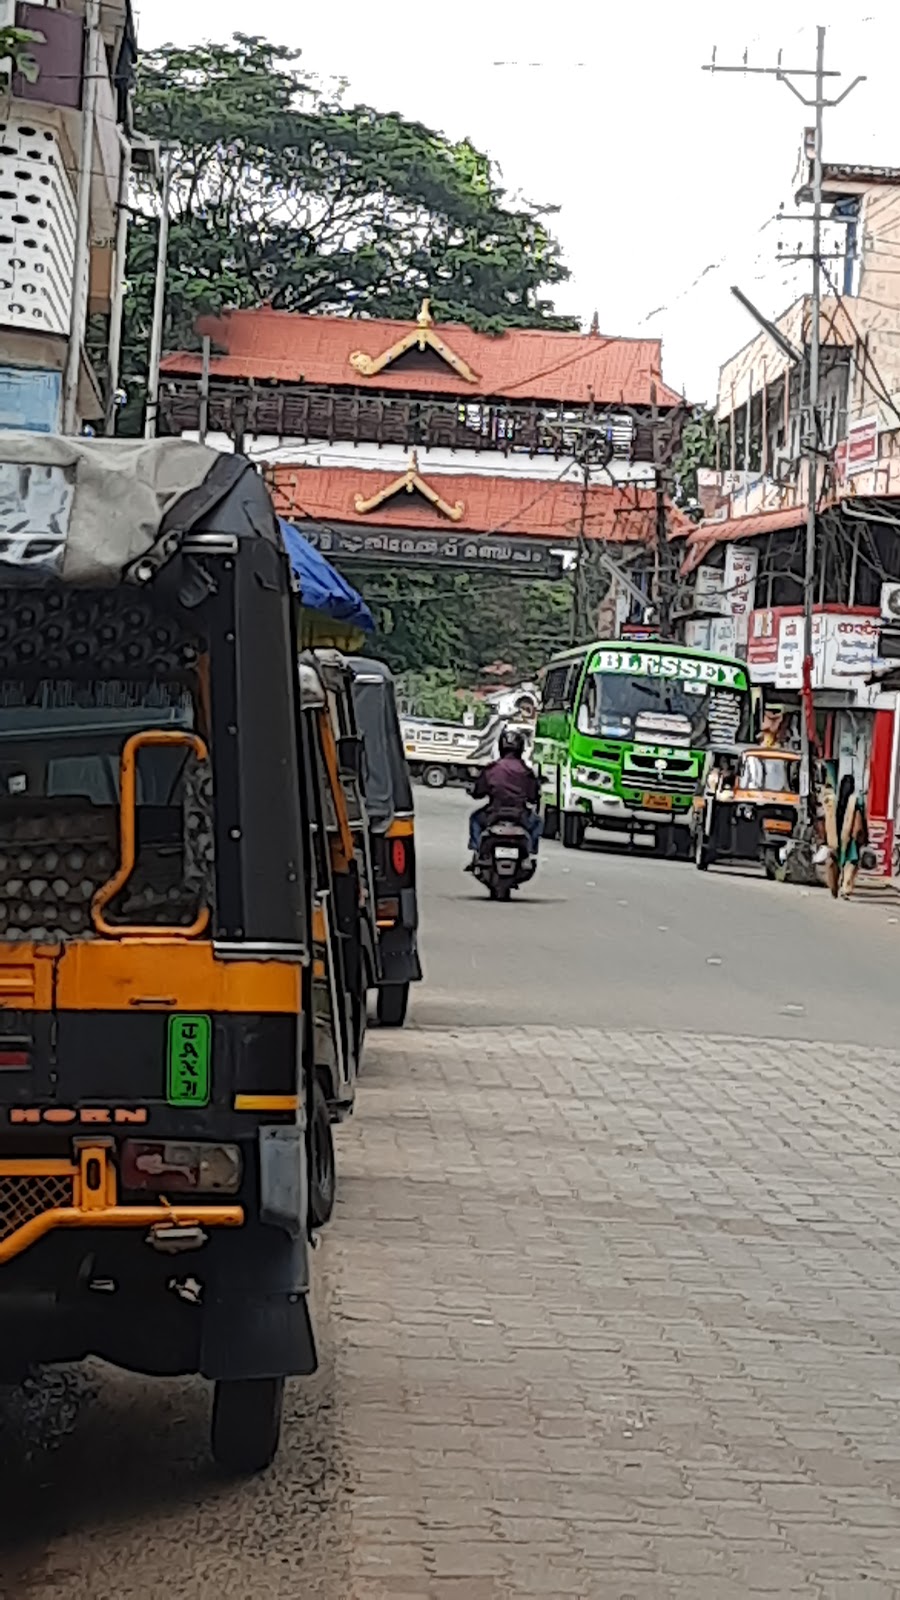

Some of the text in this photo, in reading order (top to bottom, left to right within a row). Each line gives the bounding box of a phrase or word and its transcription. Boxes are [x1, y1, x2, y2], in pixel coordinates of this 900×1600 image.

[597, 651, 743, 684] BLESSEY
[178, 1022, 199, 1097] TAXI
[9, 1107, 148, 1123] HORN
